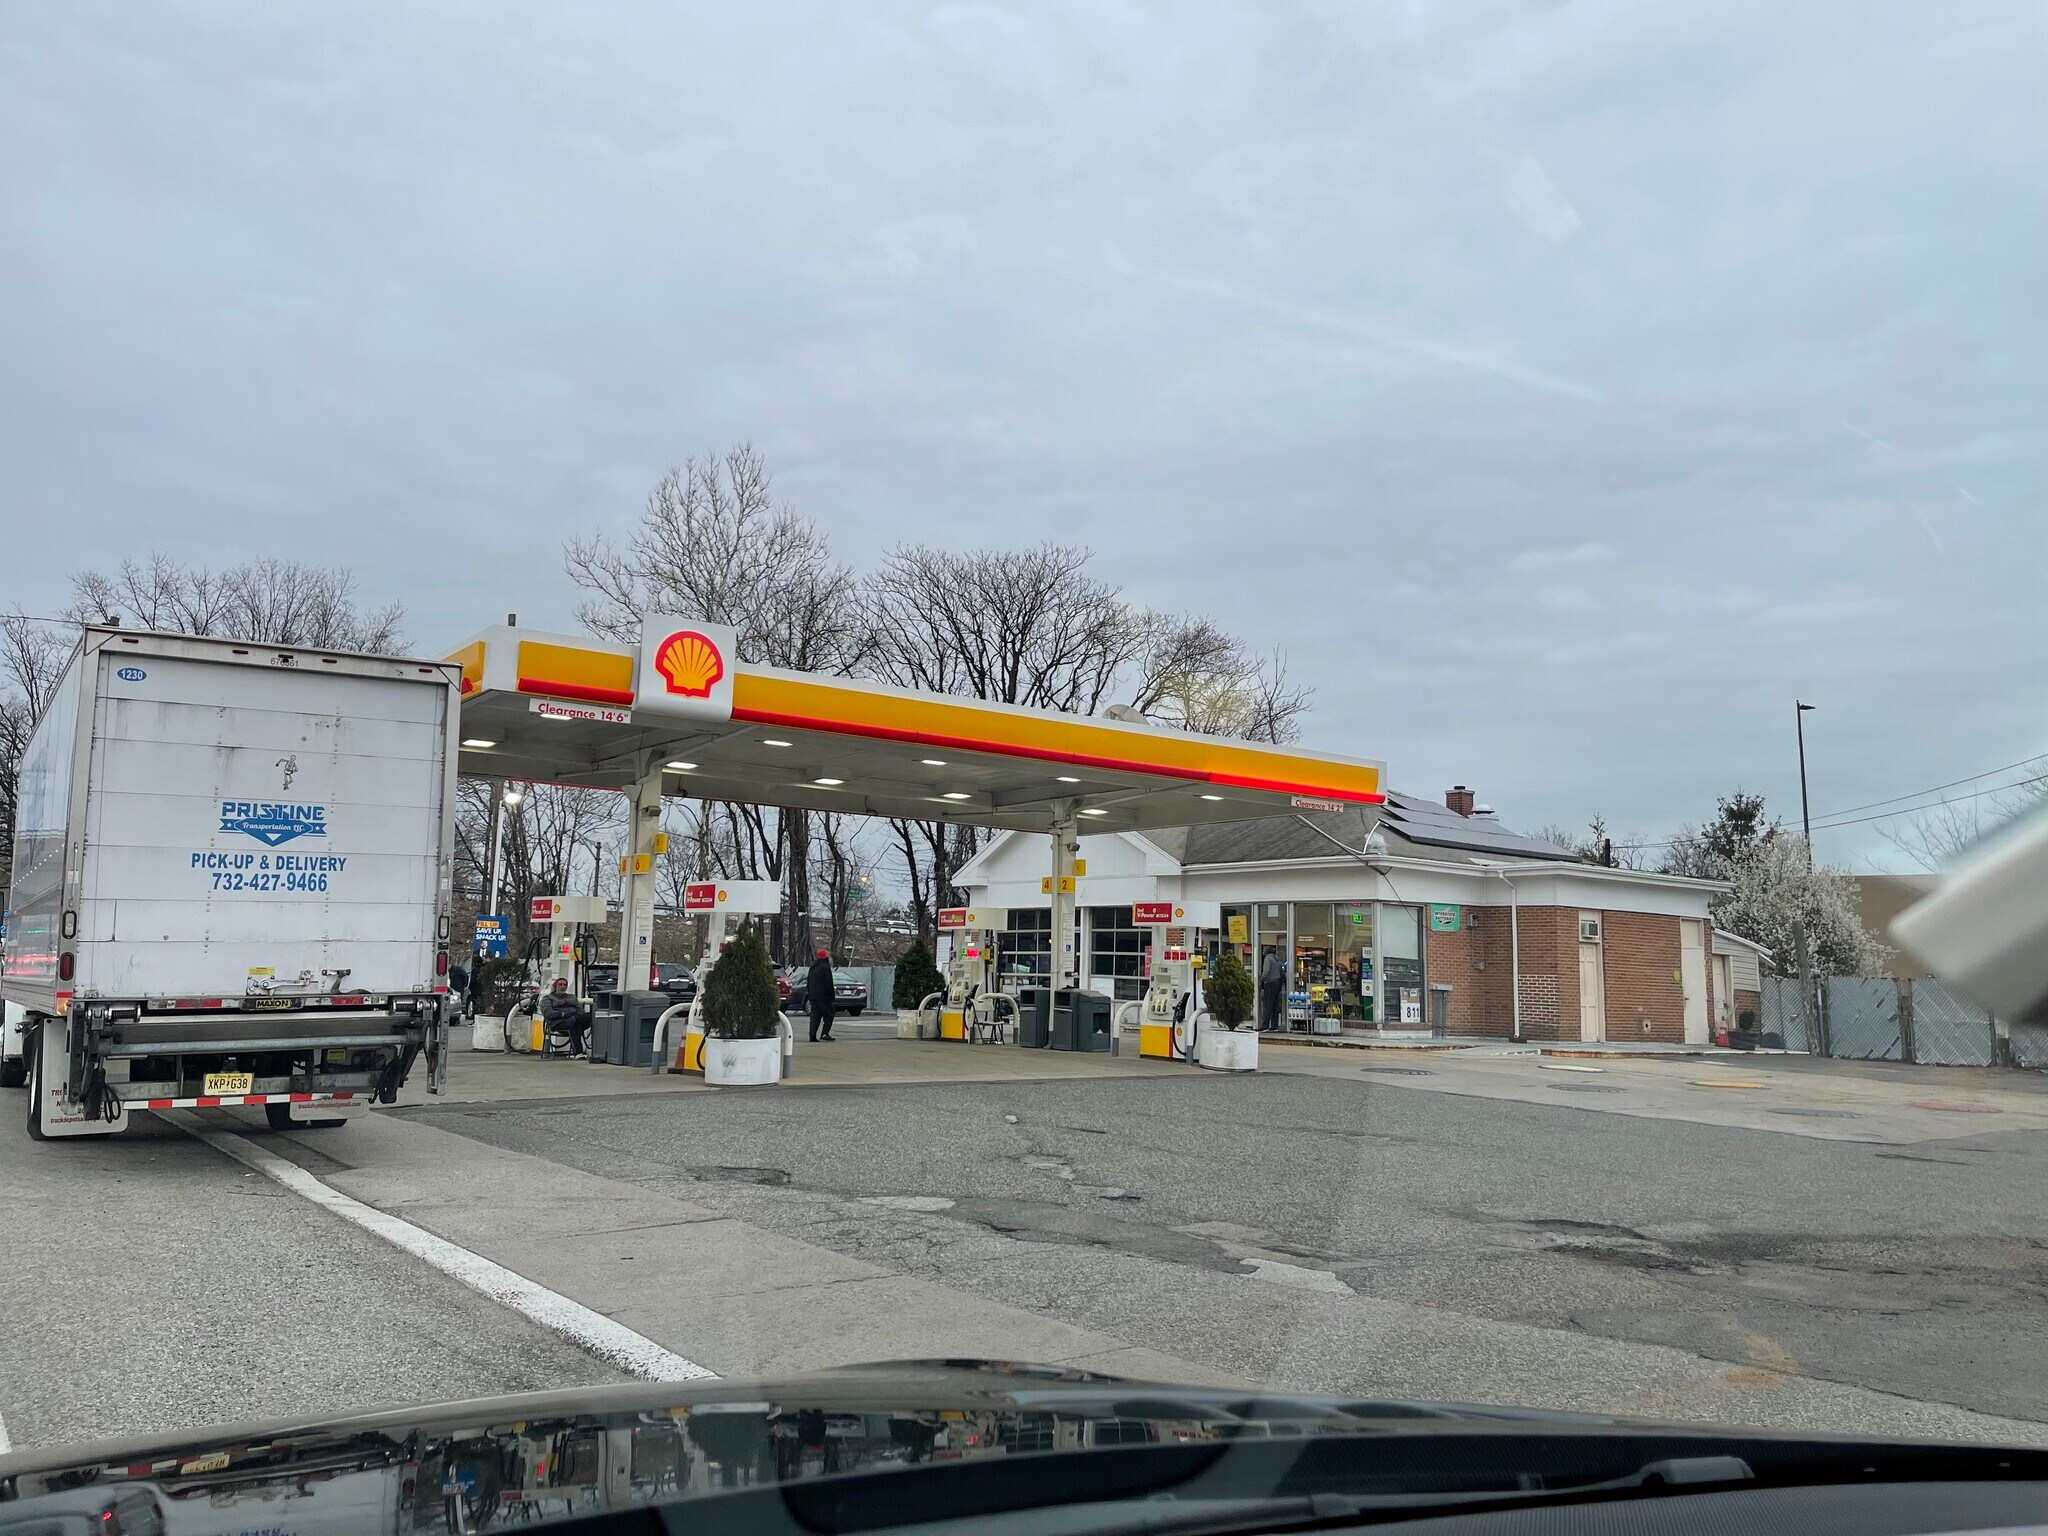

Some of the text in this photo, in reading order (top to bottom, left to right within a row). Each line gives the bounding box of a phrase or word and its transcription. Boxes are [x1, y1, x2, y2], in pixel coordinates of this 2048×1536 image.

[120, 669, 143, 680] 1230
[538, 703, 595, 719] Clearance
[1296, 799, 1325, 810] Clearance
[221, 801, 325, 821] PRISTINE
[242, 821, 291, 831] Transportation
[191, 852, 347, 872] PICK-UP & DELIVERY
[621, 859, 627, 872] 8
[635, 858, 640, 871] 6
[212, 872, 328, 892] 732-427-9466
[1044, 880, 1050, 890] 4
[1061, 879, 1067, 890] 2
[256, 999, 289, 1008] MAXON
[1406, 1006, 1420, 1018] 811
